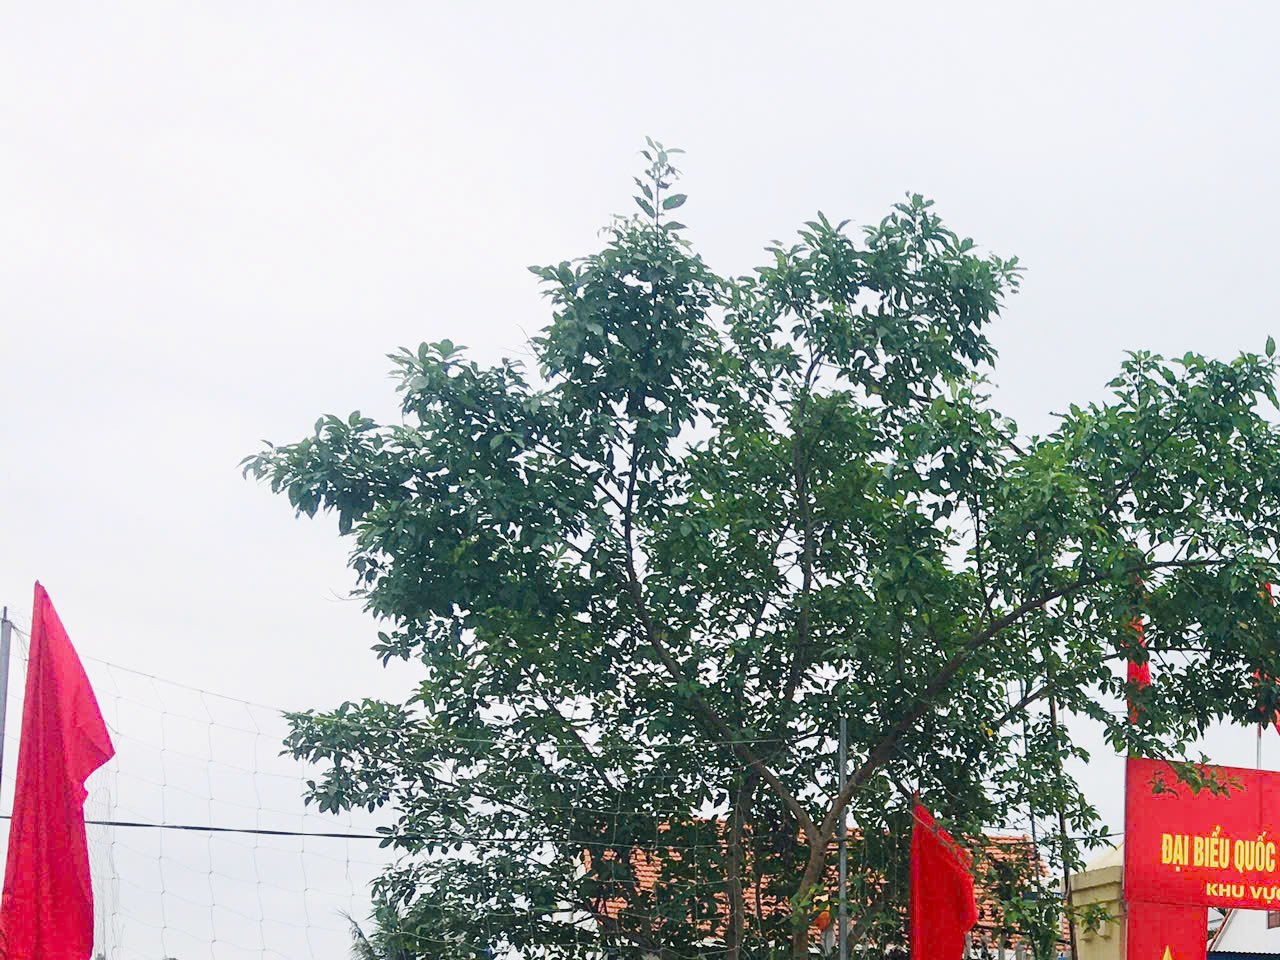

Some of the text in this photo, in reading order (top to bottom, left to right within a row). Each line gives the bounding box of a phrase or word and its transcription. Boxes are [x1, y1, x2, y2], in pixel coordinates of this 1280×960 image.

[1162, 833, 1188, 872] ĐẠI
[1194, 825, 1230, 868] BIỂU
[1234, 831, 1276, 873] QUỐC
[1206, 883, 1244, 898] KHU
